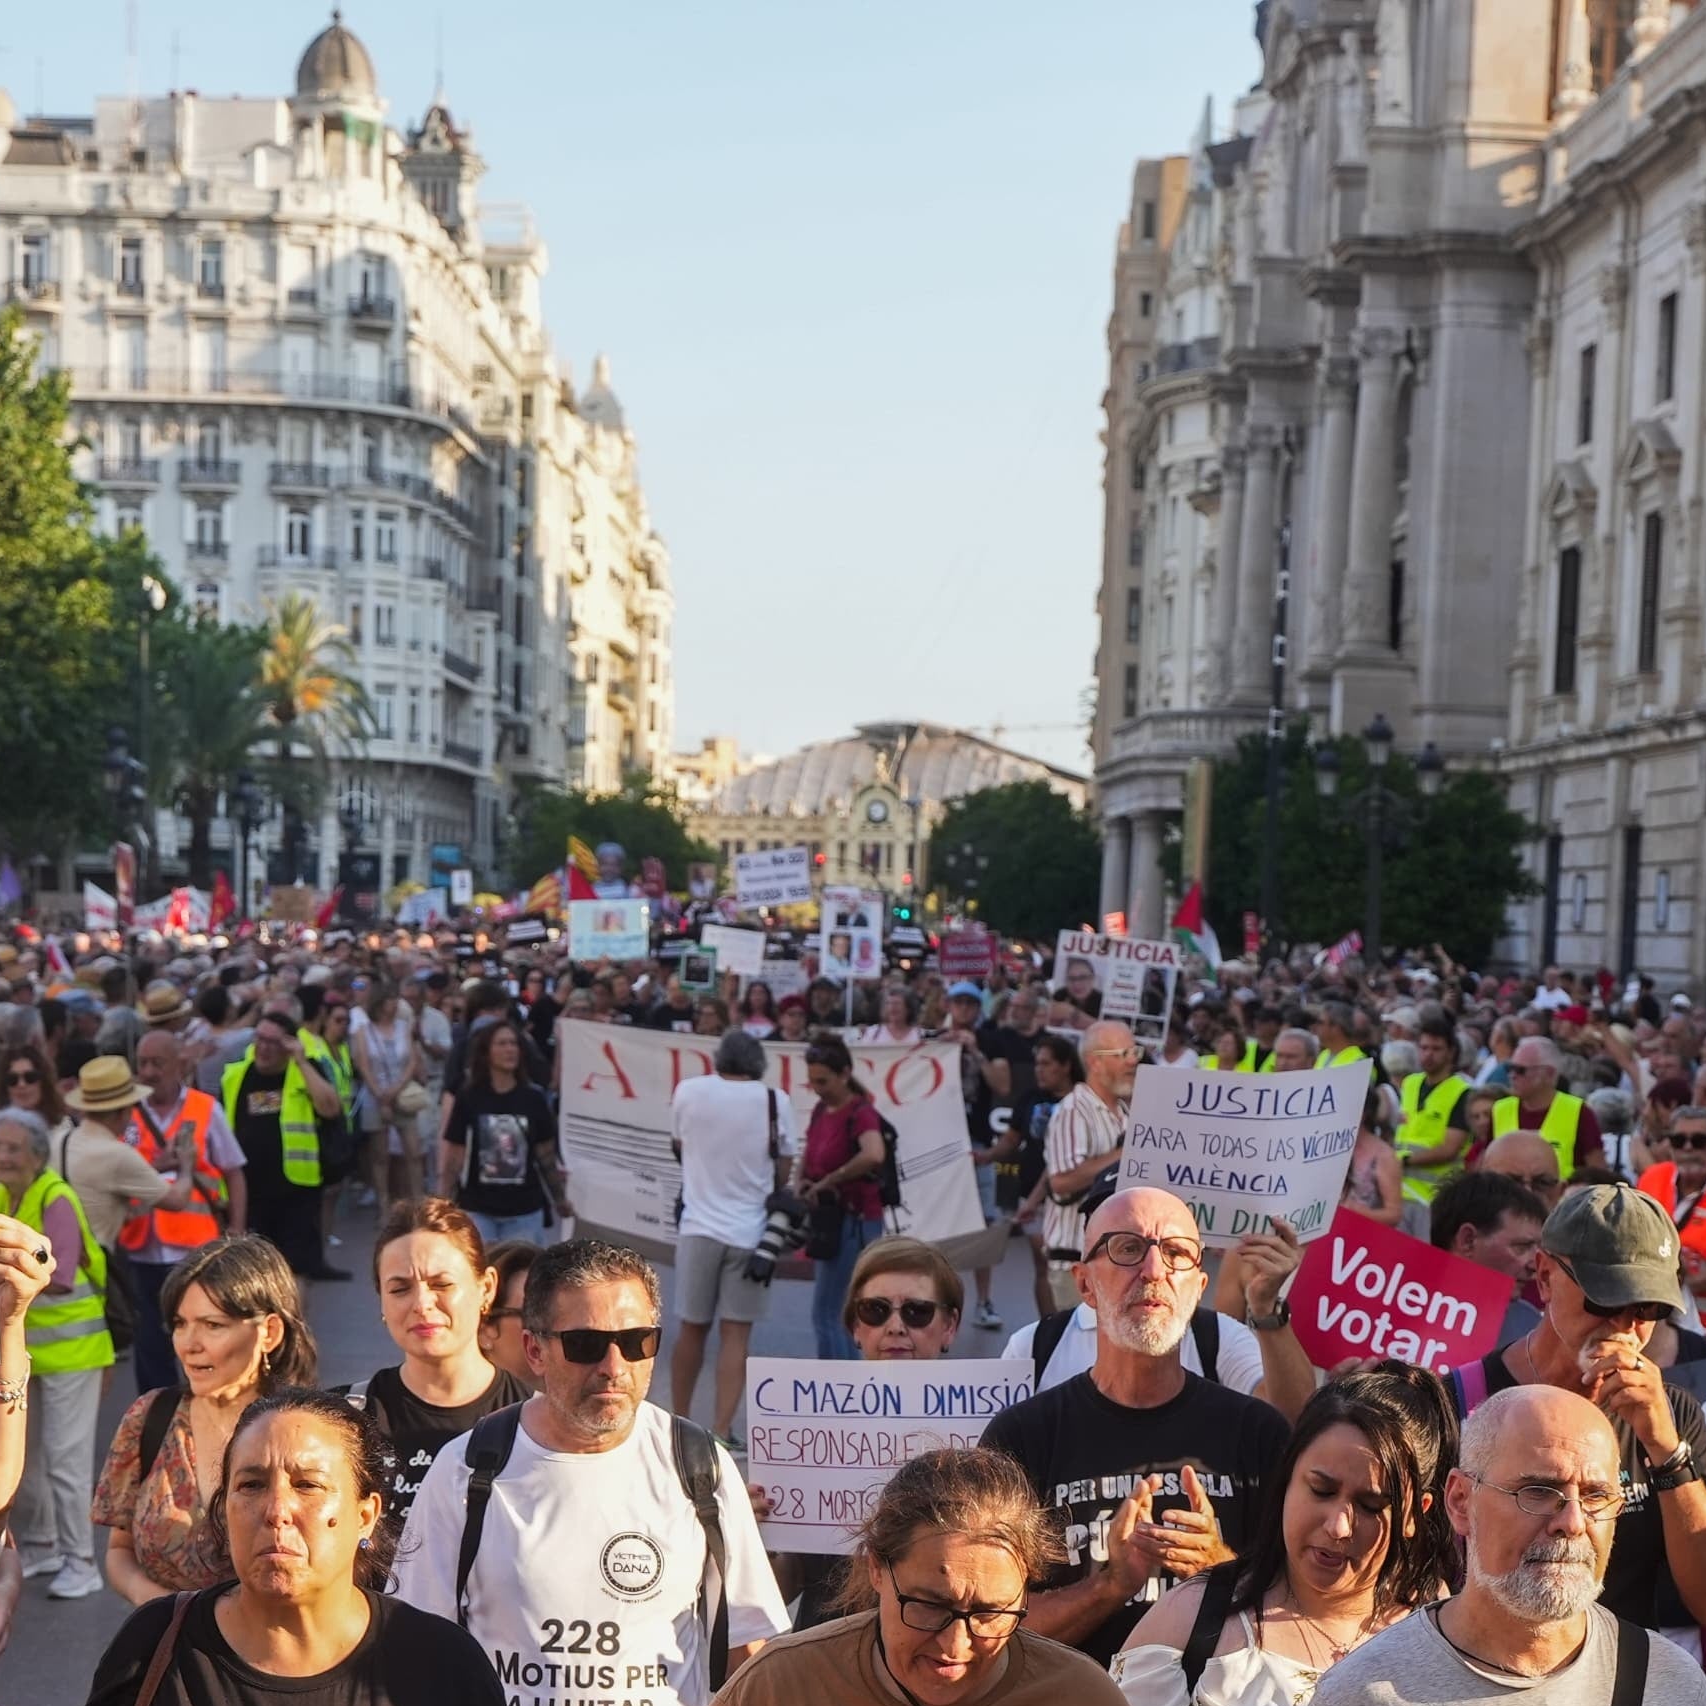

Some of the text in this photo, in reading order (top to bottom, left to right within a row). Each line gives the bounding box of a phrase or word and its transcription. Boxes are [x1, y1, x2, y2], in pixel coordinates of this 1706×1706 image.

[1063, 936, 1174, 964] JUSTICIA
[1176, 1082, 1336, 1114] JUSTICIA
[1131, 1123, 1357, 1161] PARA TODAS LAS VÍCTIMAS
[1127, 1159, 1288, 1195] DE VALÈNCIA
[1331, 1237, 1478, 1336] Volem
[1317, 1295, 1450, 1375] votar.
[756, 1374, 1033, 1416] C. MAZÓN DIMISSIÓ
[751, 1426, 919, 1467] RESPONSABLE
[1055, 1479, 1097, 1507] PER
[1152, 1473, 1234, 1498] ESLA
[613, 1562, 650, 1574] DANA
[540, 1619, 621, 1656] 228
[626, 1664, 669, 1689] PER
